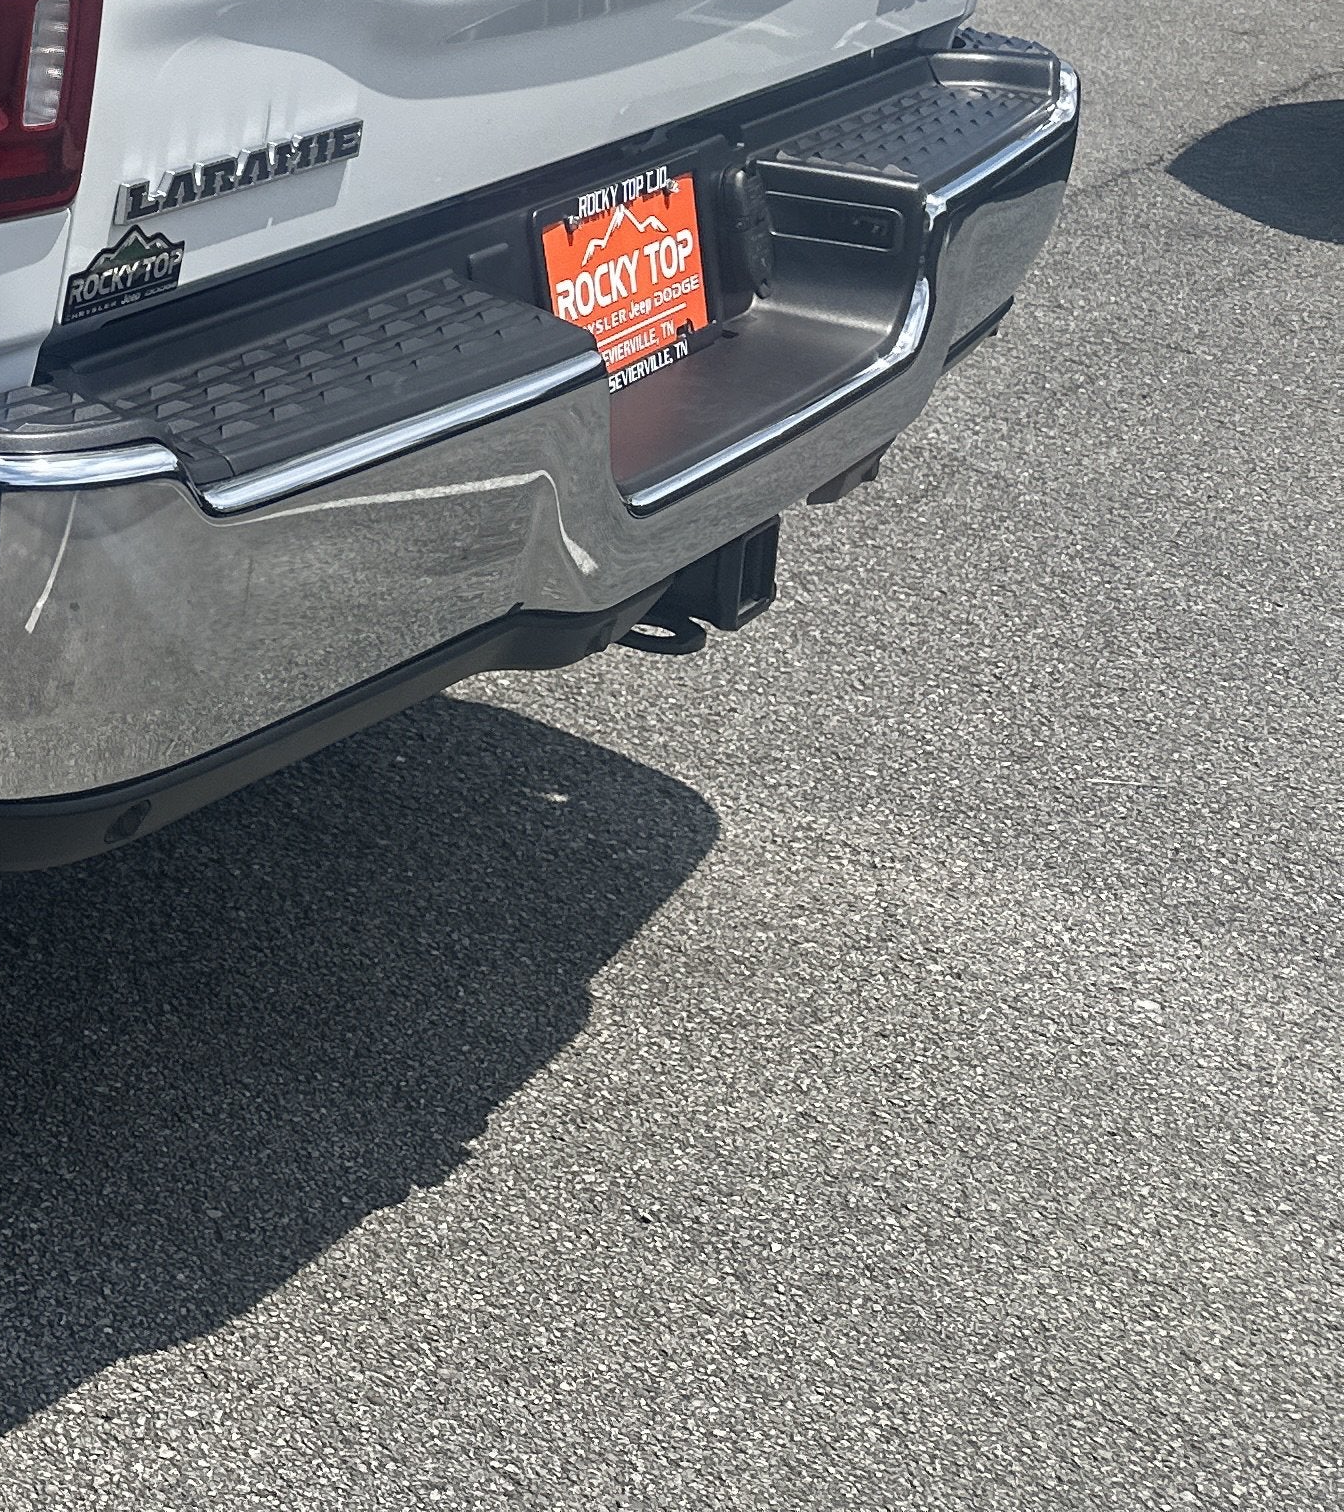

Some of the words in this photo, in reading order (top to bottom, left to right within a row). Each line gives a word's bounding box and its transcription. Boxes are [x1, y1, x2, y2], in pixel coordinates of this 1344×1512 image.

[113, 118, 364, 226] LARAMIE
[578, 184, 619, 218] ROCKY
[622, 175, 644, 203] TOP
[68, 260, 141, 306] ROCKY
[142, 247, 183, 282] TOP
[555, 249, 641, 322] ROCKY
[644, 228, 694, 285] TOP
[628, 299, 652, 320] Jeep
[653, 275, 700, 306] DODGE
[602, 330, 659, 367] EVIERVILLE,
[661, 320, 675, 339] TN
[608, 347, 675, 394] SEVIERVILLE,
[674, 338, 689, 357] TN
